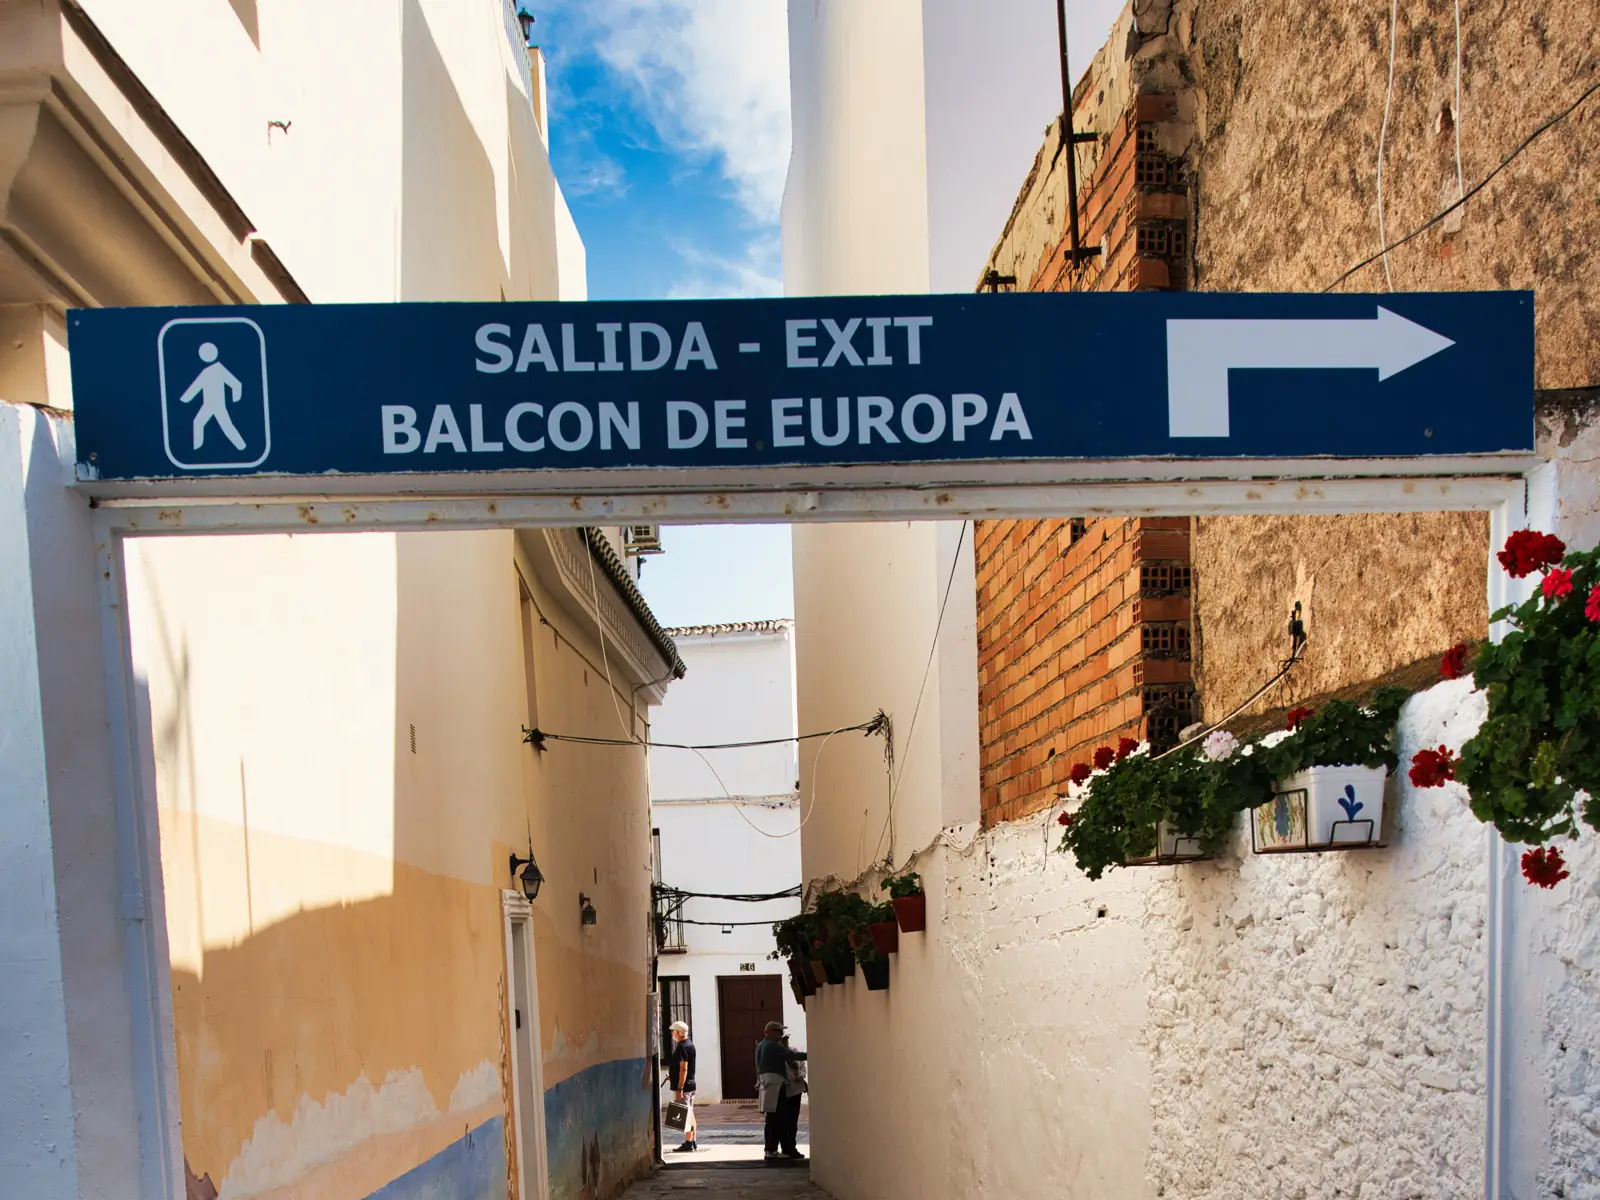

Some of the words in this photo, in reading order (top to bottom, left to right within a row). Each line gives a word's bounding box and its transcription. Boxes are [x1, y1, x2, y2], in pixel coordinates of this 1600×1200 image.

[475, 322, 717, 375] SALIDA
[739, 342, 760, 352] -
[785, 316, 933, 369] EXIT
[381, 401, 641, 454] BALCON
[666, 400, 748, 449] DE
[771, 392, 1033, 448] EUROPA
